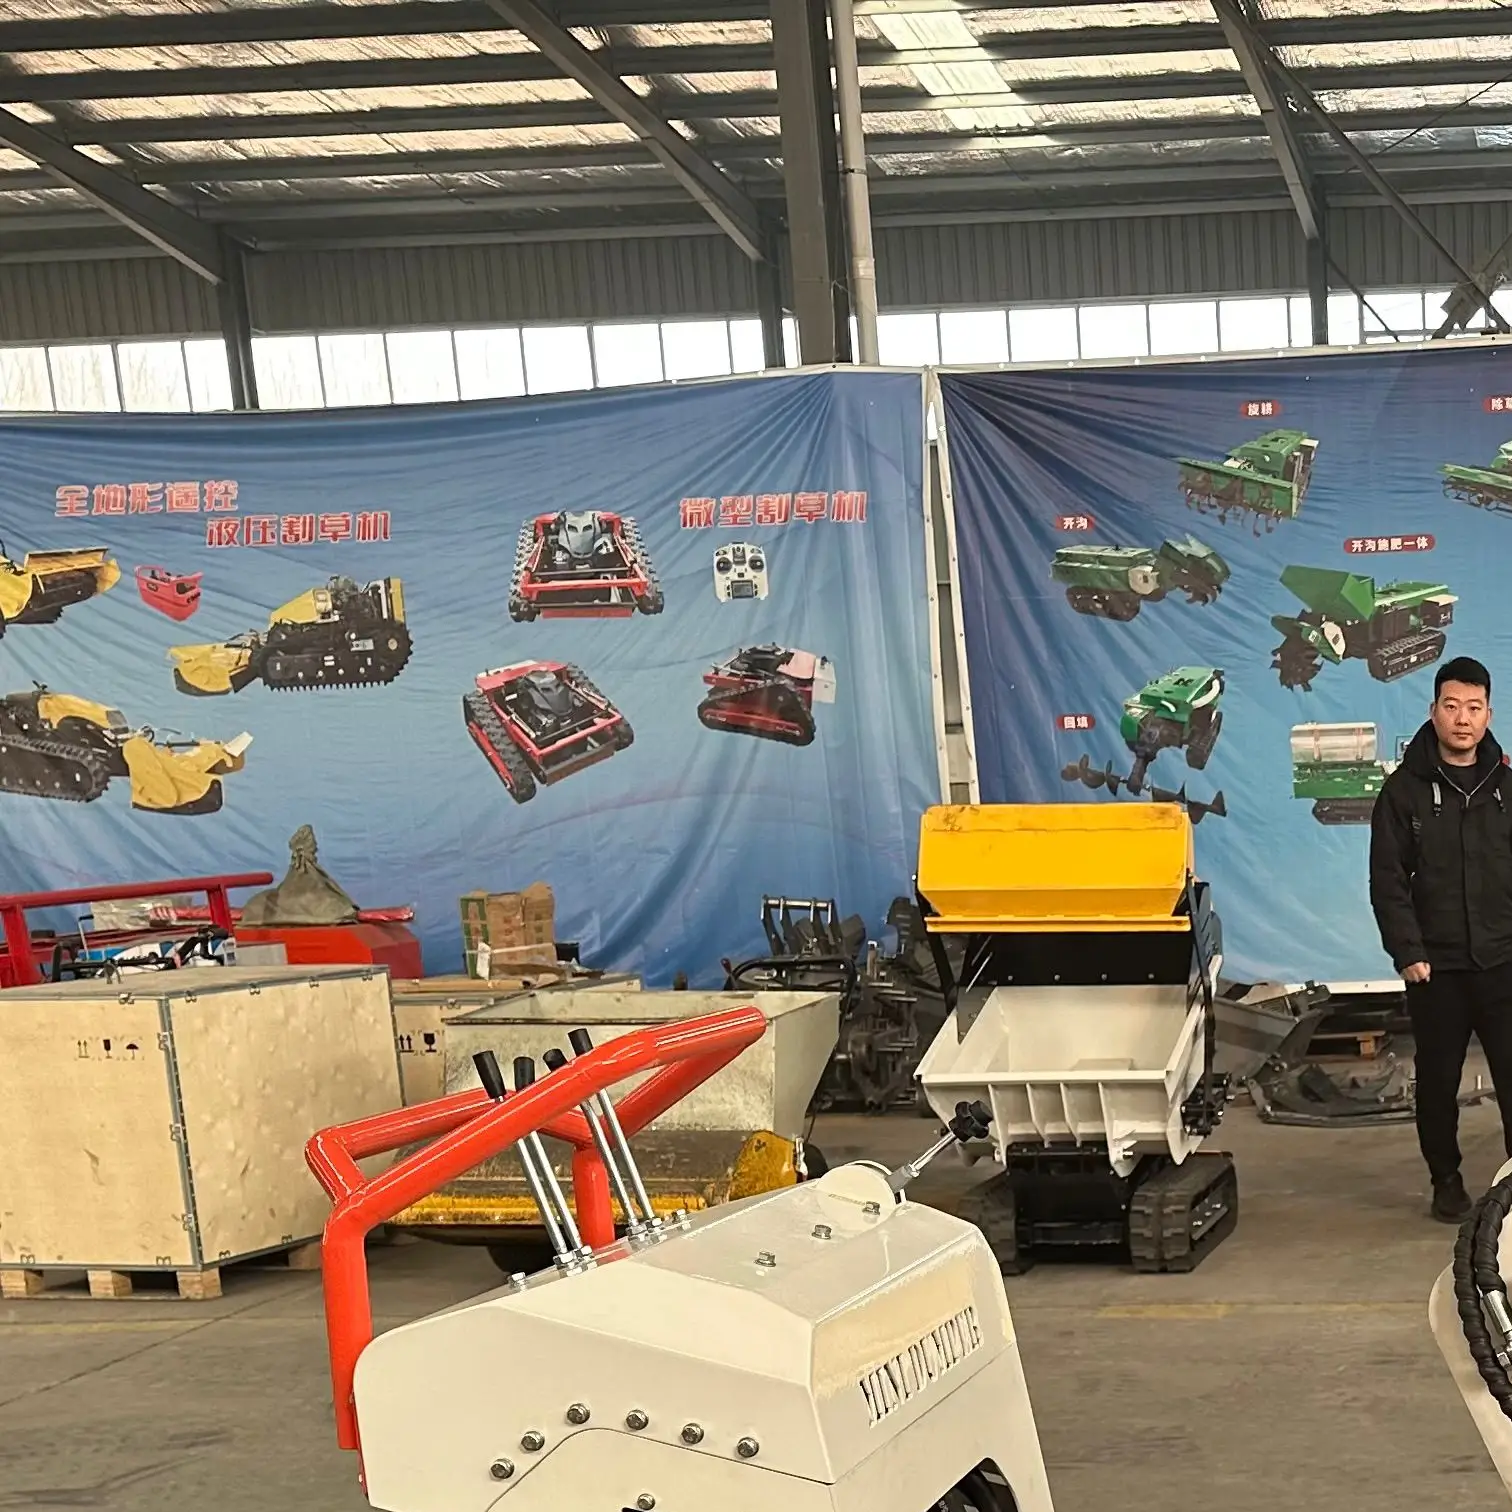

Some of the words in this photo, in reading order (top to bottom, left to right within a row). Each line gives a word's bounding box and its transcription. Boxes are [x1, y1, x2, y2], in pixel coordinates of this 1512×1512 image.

[55, 480, 239, 517] 全地形遥控
[679, 490, 868, 529] 微型割草机
[207, 510, 391, 549] 液压割草机
[1063, 516, 1088, 530] 开沟
[1351, 536, 1428, 553] 开沟施肥一体
